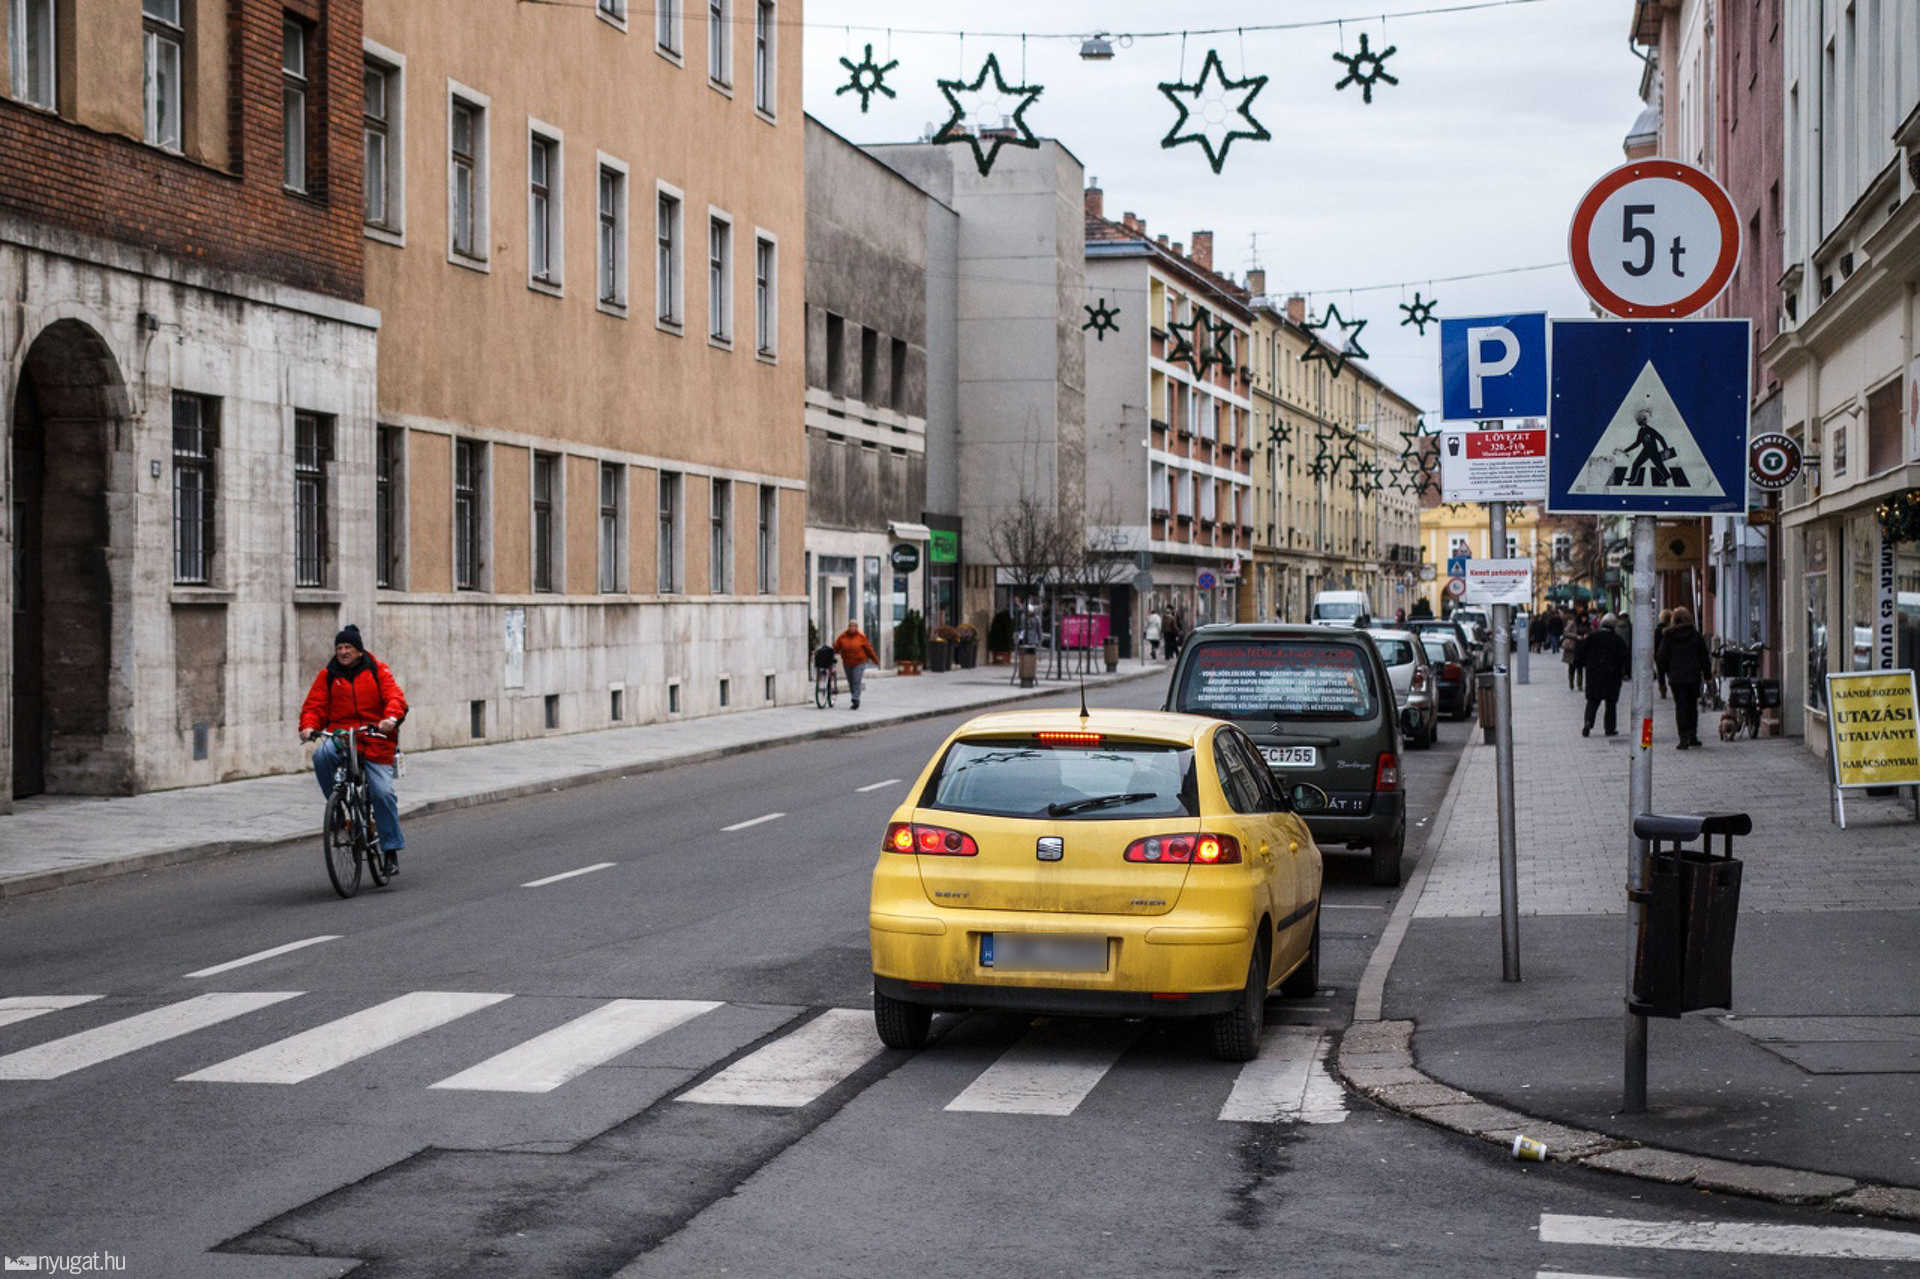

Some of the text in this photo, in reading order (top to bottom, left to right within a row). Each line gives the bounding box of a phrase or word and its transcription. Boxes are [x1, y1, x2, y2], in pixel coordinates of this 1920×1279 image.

[1622, 204, 1686, 278] 5 t
[1467, 326, 1521, 409] P
[1753, 437, 1793, 450] NEMZETI
[1768, 456, 1778, 467] T
[1835, 687, 1911, 698] AJÁNDÉKOZZON
[1837, 705, 1913, 723] UTAZÁSI
[1838, 728, 1916, 742] UTALVÁNYT
[1328, 797, 1348, 809] ÁT
